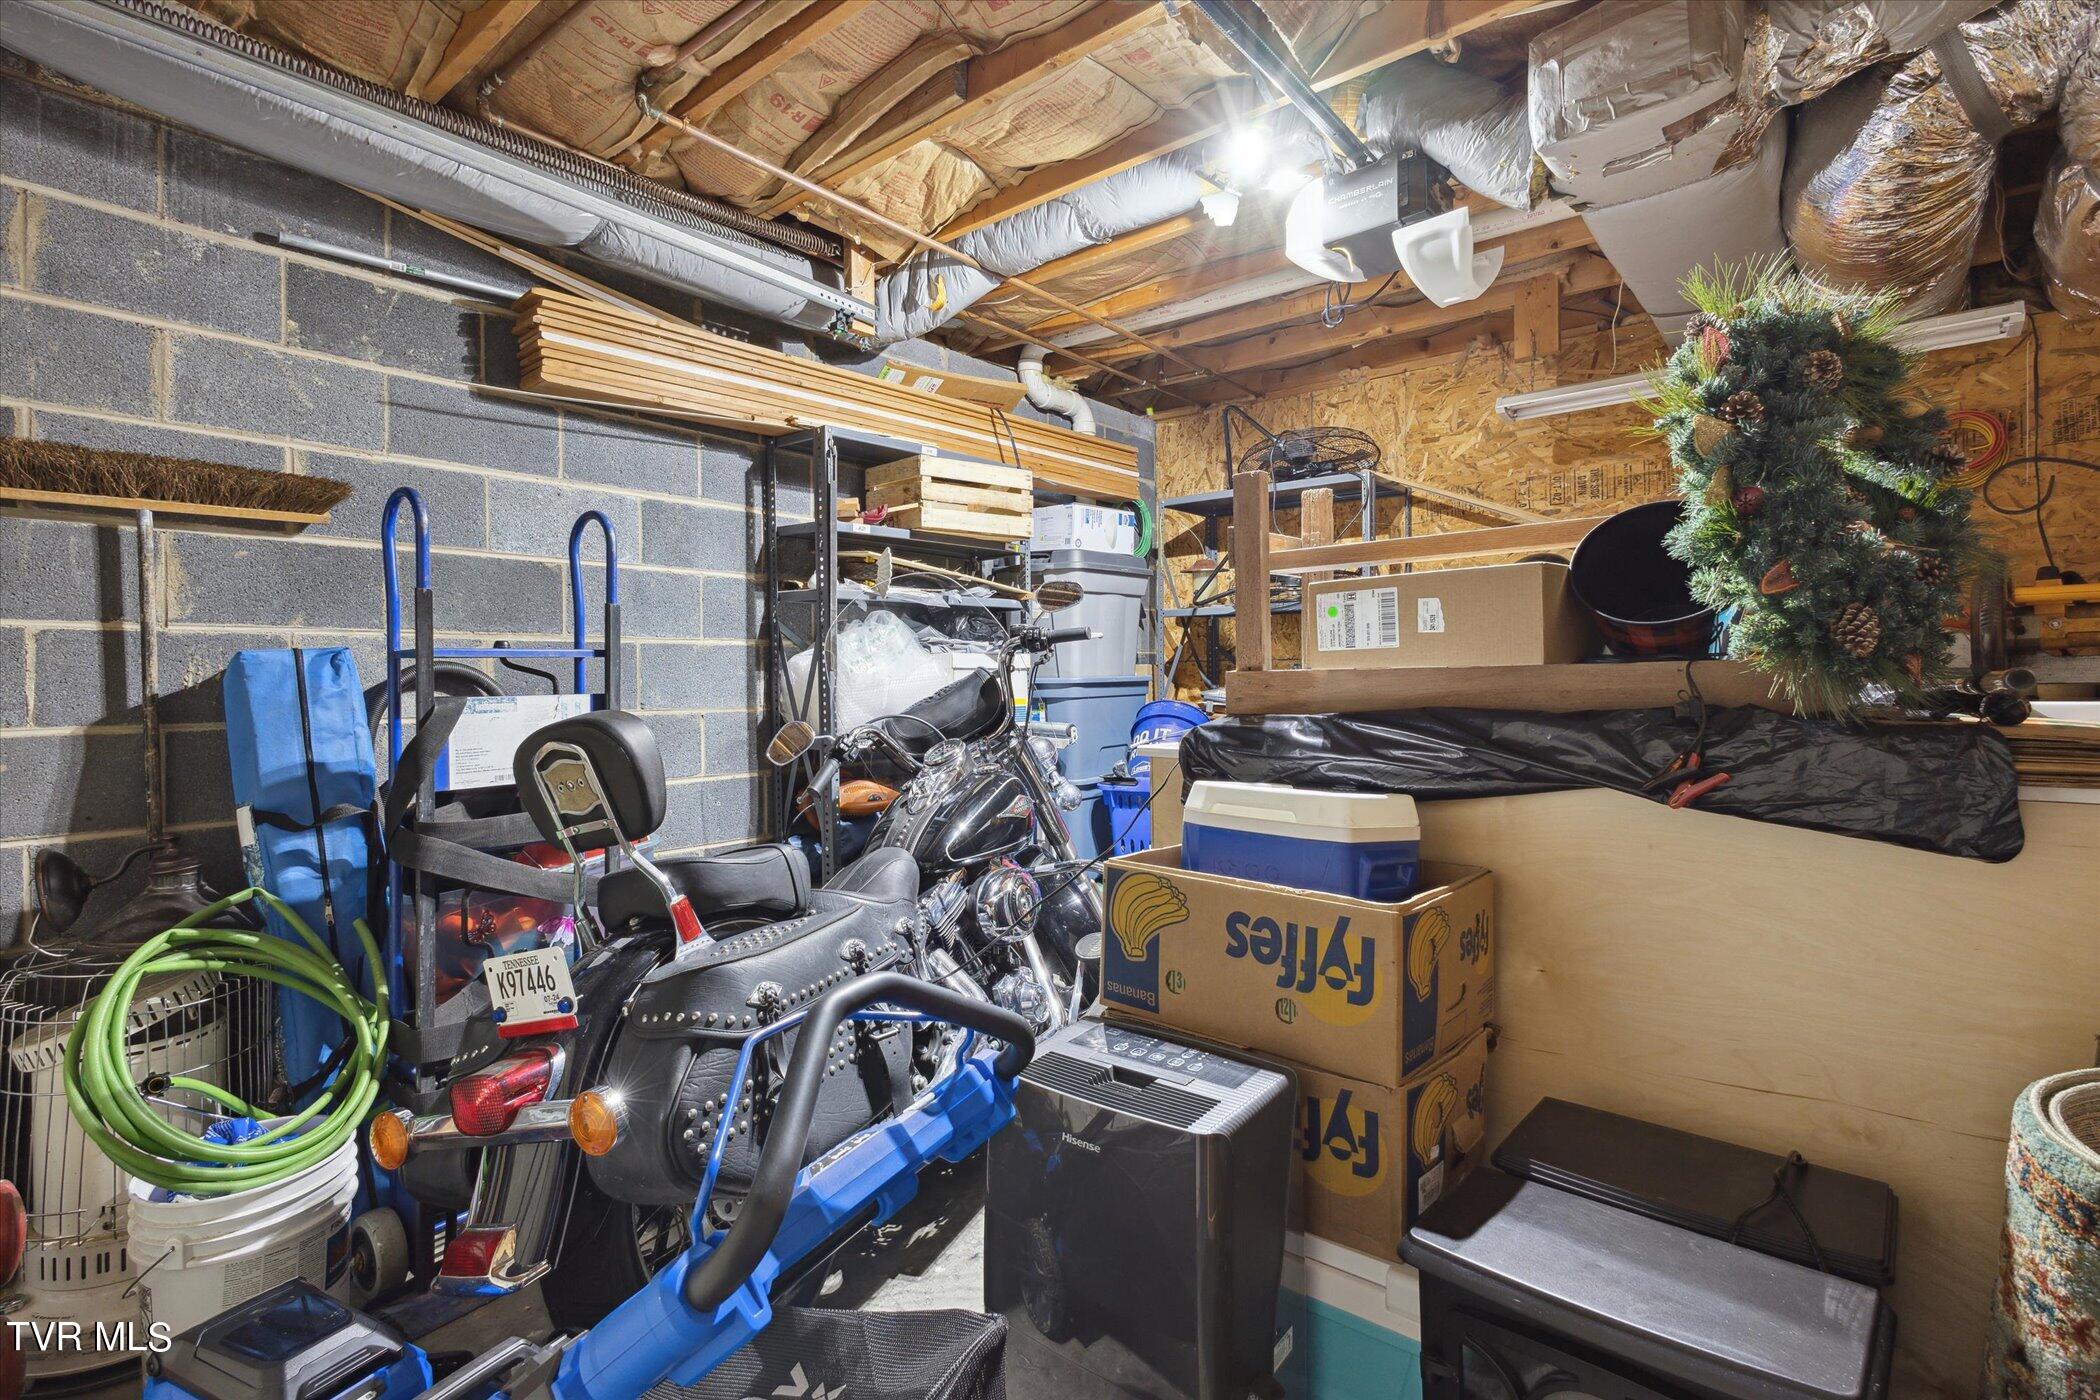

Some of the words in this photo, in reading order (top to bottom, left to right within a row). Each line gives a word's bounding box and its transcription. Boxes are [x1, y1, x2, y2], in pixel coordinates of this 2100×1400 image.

[590, 14, 636, 50] R-19
[768, 91, 808, 125] R-19
[1328, 176, 1394, 206] CHAMBERLAIN
[502, 955, 540, 971] TENNESSEE
[496, 964, 556, 1000] K97446
[1107, 980, 1156, 1006] Bananas
[543, 993, 561, 1004] 07-24
[1061, 1131, 1101, 1154] Hisense
